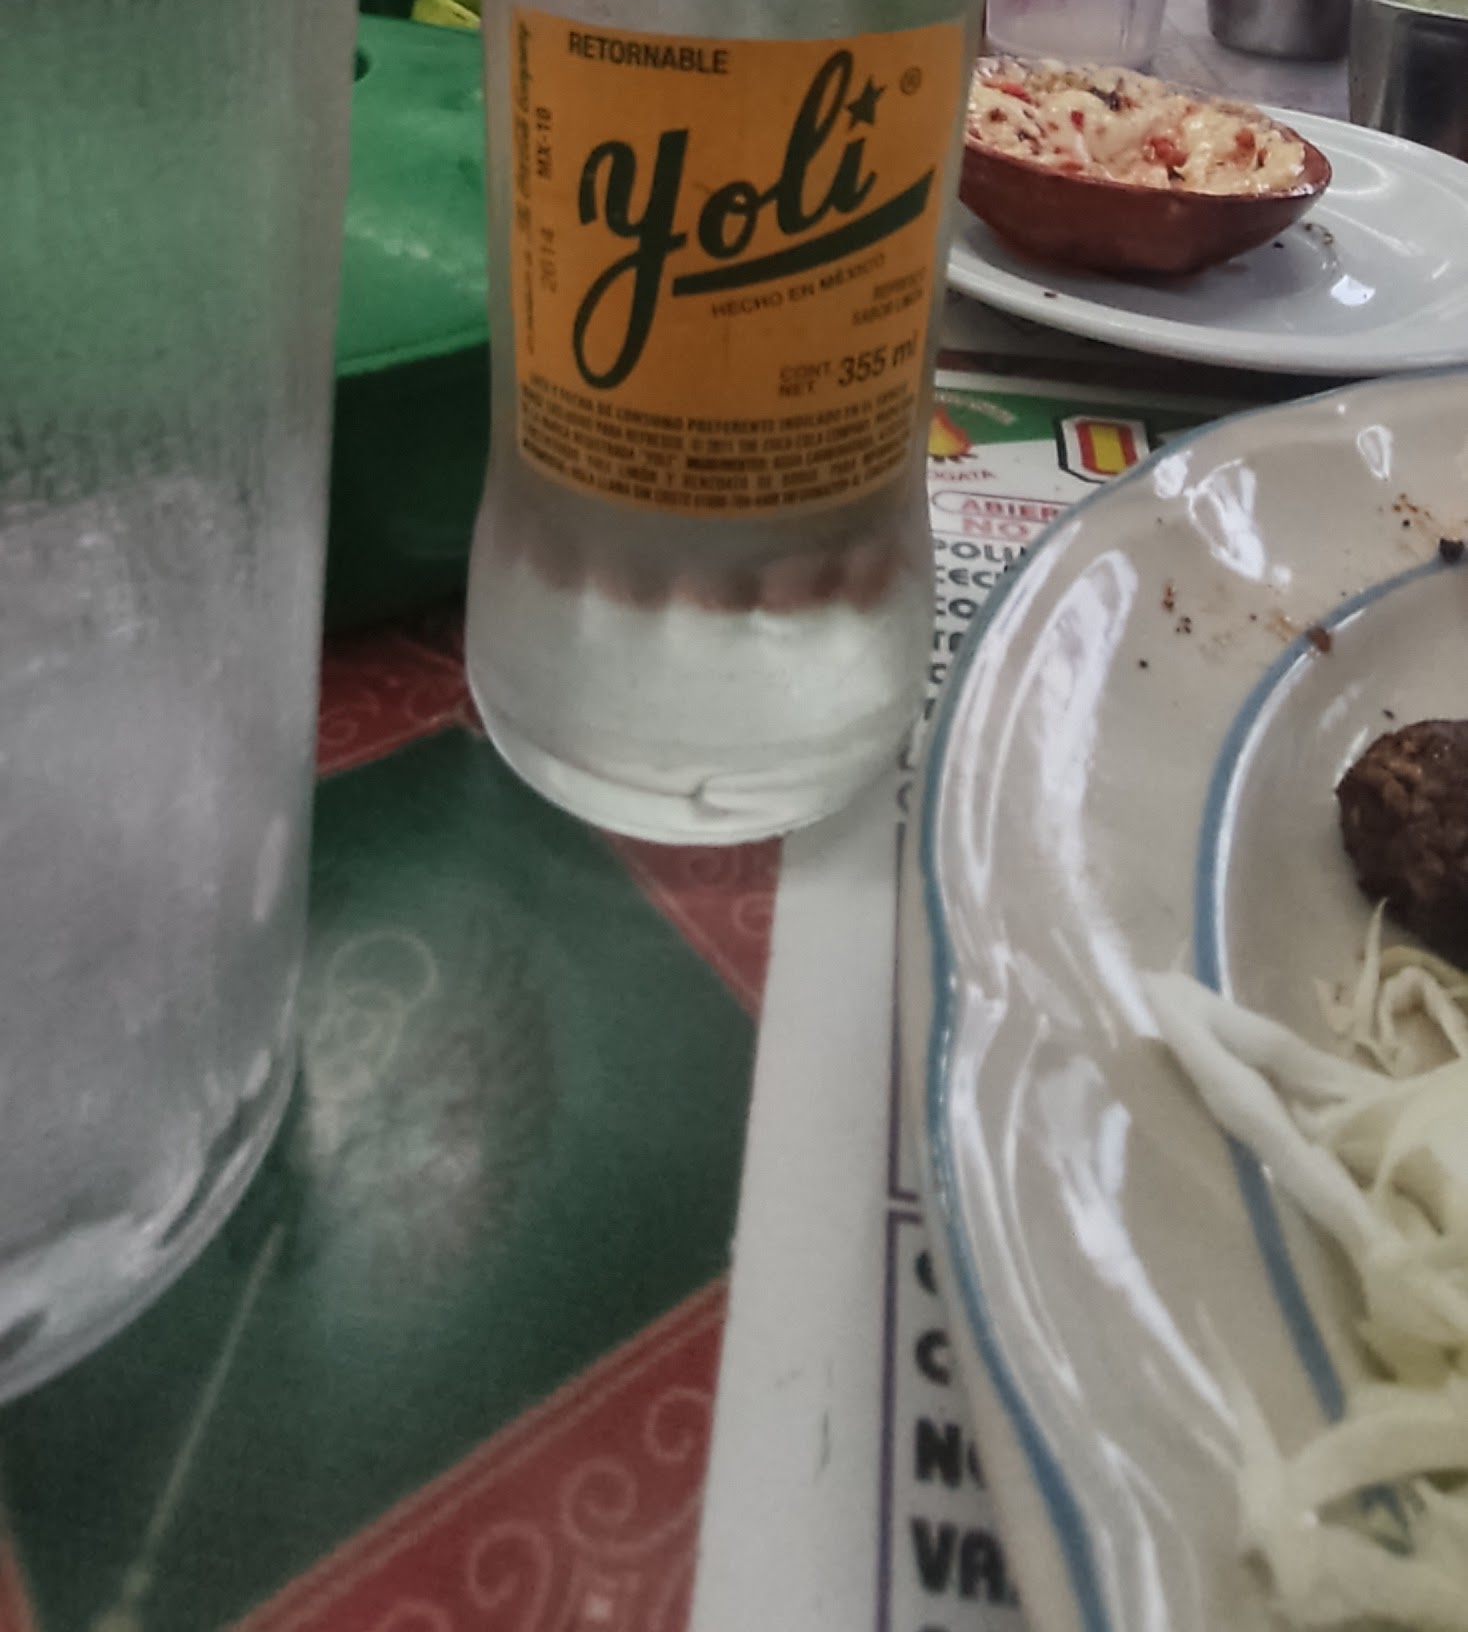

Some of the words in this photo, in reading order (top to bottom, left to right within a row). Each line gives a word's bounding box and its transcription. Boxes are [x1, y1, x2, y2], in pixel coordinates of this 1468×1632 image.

[568, 31, 731, 75] RETORNABLE
[711, 291, 784, 318] HECHO
[788, 282, 816, 303] EN
[837, 344, 889, 388] 355
[891, 327, 920, 368] ml
[909, 1517, 1021, 1611] VA
